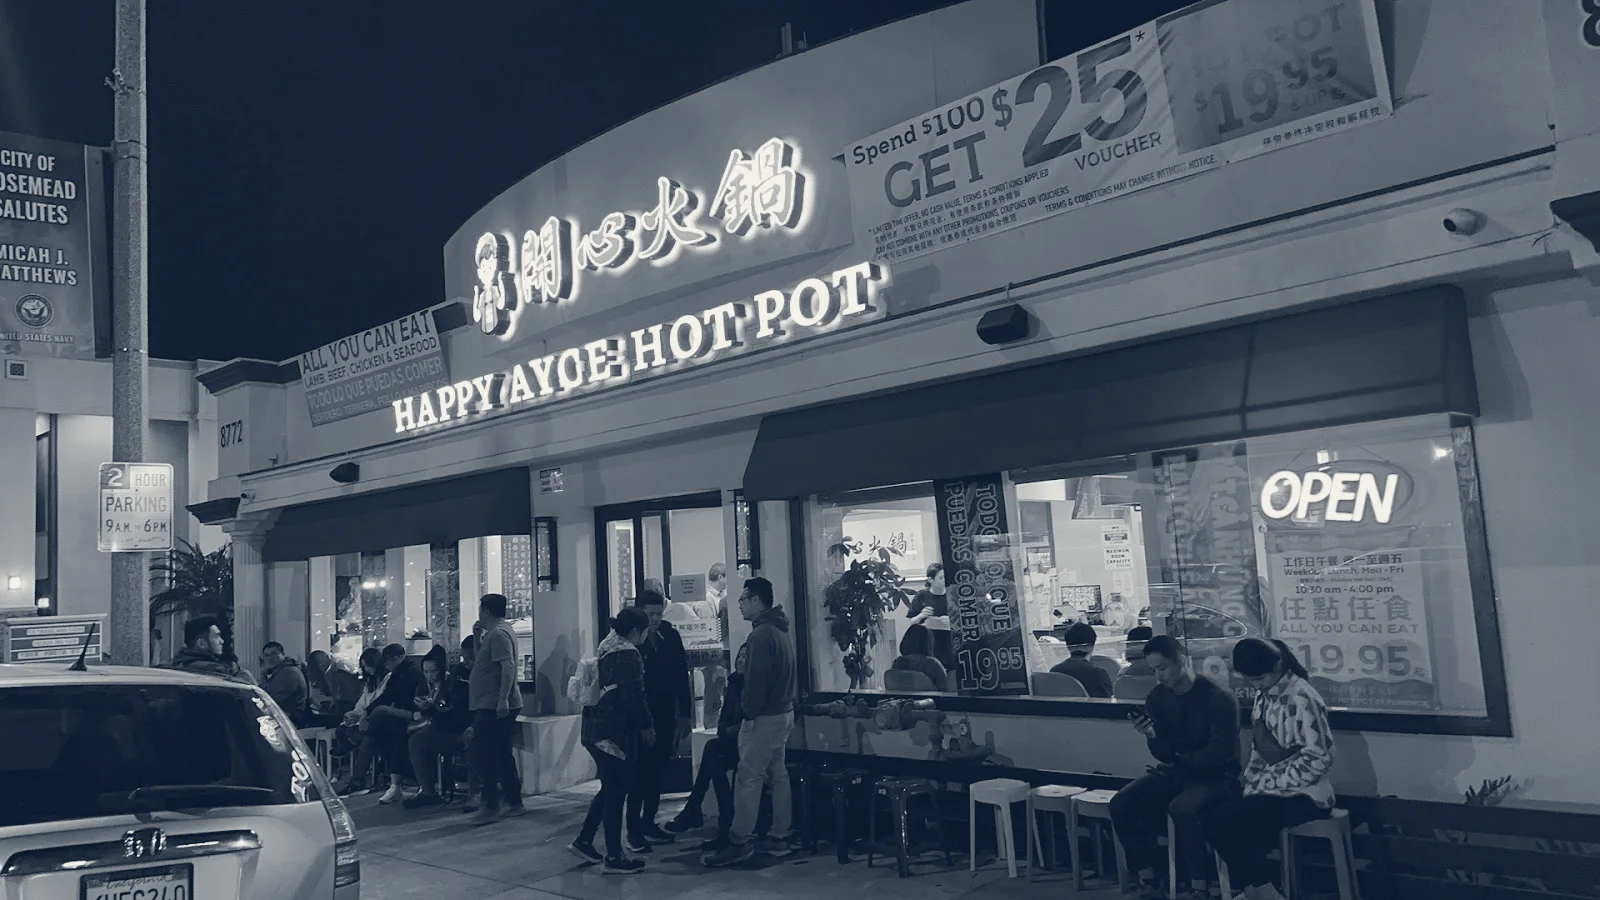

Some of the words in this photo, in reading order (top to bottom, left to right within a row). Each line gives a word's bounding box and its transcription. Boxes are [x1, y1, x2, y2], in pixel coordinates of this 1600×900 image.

[853, 125, 917, 166] Spend
[922, 95, 986, 136] $100
[0, 150, 33, 169] CITY
[37, 155, 55, 172] OF
[884, 130, 987, 208] GET
[1074, 131, 1162, 171] VOUCHER
[872, 222, 892, 235] LIMITED
[930, 204, 943, 215] CASH
[963, 192, 982, 204] TERMS
[989, 177, 1024, 195] CONDITIONS
[1024, 168, 1049, 185] APPLIED
[1044, 200, 1067, 213] TERMS
[1067, 198, 1074, 206] &
[1074, 186, 1113, 204] CONDITIONS
[1113, 181, 1128, 194] MAY
[1128, 171, 1155, 188] CHANGE
[1155, 162, 1187, 179] WITHOUT
[0, 199, 68, 225] ALUTES
[895, 234, 918, 247] COMBINE
[918, 229, 932, 240] WITH
[932, 227, 943, 236] ANY
[943, 219, 961, 233] OTHER
[1001, 199, 1027, 214] COUPONS
[1027, 196, 1038, 206] OR
[1037, 185, 1070, 202] VOUCHERS
[1, 264, 77, 286] ATTHEWS
[56, 249, 69, 265] J.
[25, 333, 52, 343] STATES
[54, 335, 74, 344] NAVY
[303, 348, 328, 375] ALL
[328, 335, 360, 365] YOU
[363, 323, 397, 355] CAN
[398, 309, 431, 342] EAT
[350, 353, 386, 374] CHICKEN
[386, 352, 393, 363] &
[394, 336, 437, 361] SEAFOOD
[391, 372, 494, 433] HAPPY
[631, 302, 739, 372] HOT
[754, 260, 873, 340] POT
[308, 390, 332, 410] TODO
[331, 387, 344, 403] LO
[344, 380, 366, 399] QUE
[365, 367, 405, 391] PUEDAS
[405, 356, 444, 382] COMER
[220, 419, 243, 448] 8772
[107, 467, 123, 487] 2
[135, 473, 167, 487] HOUR
[106, 496, 167, 513] PARKING
[1260, 470, 1398, 524] OPEN
[944, 482, 972, 563] PUEDAS
[1361, 566, 1382, 574] Mon
[1389, 565, 1405, 574] Fri
[954, 569, 981, 642] COMER
[1279, 594, 1413, 623] 任點任食
[1295, 584, 1322, 594] 10:30
[1324, 586, 1342, 594] am
[1349, 584, 1374, 593] 4:00
[1376, 585, 1395, 595] pm
[987, 586, 1013, 634] QUE
[1279, 623, 1308, 634] ALL
[1312, 623, 1344, 634] YOU
[1347, 623, 1382, 634] CAN
[1387, 623, 1418, 634] EAT
[1288, 644, 1412, 677] 19.95
